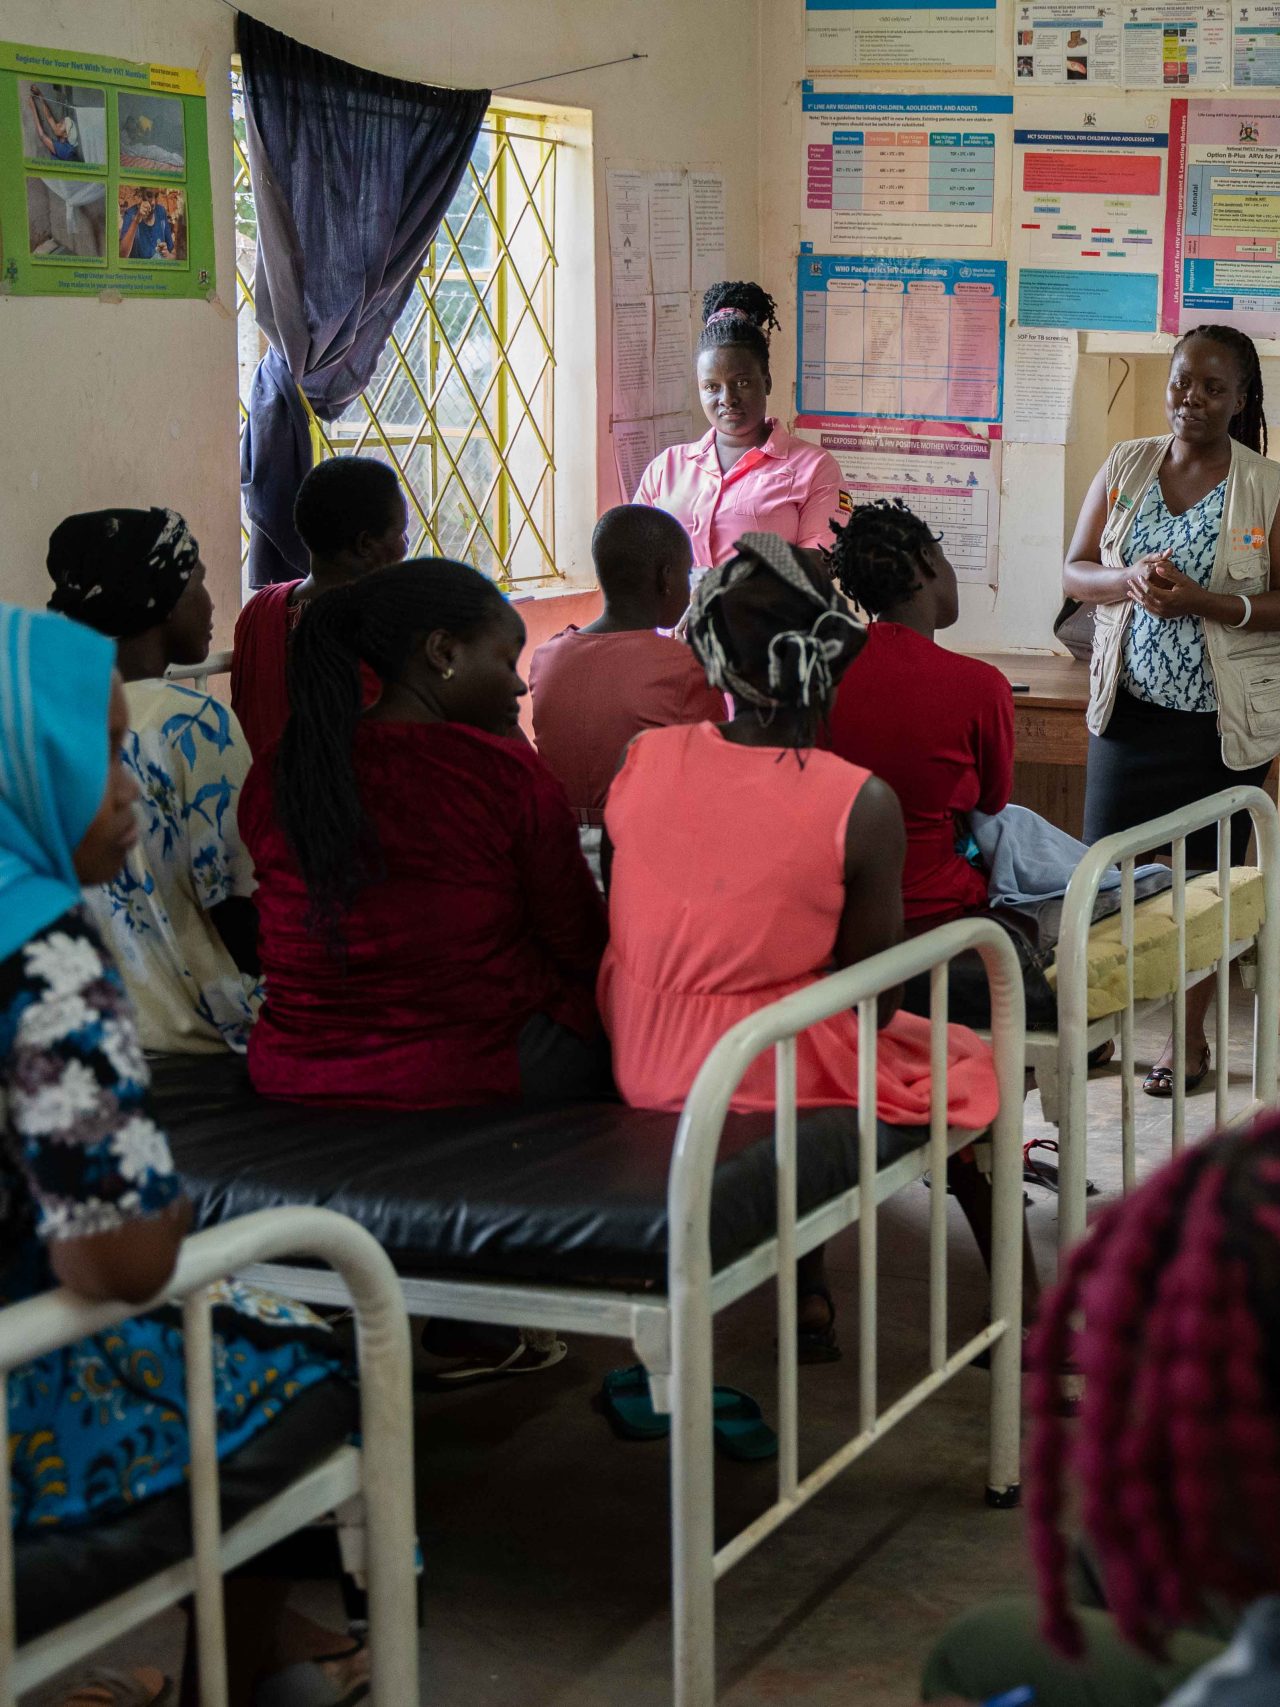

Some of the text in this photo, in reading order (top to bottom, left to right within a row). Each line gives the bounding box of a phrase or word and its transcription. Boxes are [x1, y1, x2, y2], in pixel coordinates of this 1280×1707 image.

[1206, 152, 1226, 160] Option
[924, 268, 948, 276] Staging
[822, 437, 857, 446] HIV-EXPOSED
[859, 439, 877, 447] INFANT
[885, 440, 895, 448] HIV
[896, 441, 920, 449] POSITIVE
[921, 442, 945, 451] MOTHER
[960, 444, 987, 453] SCHEDULE
